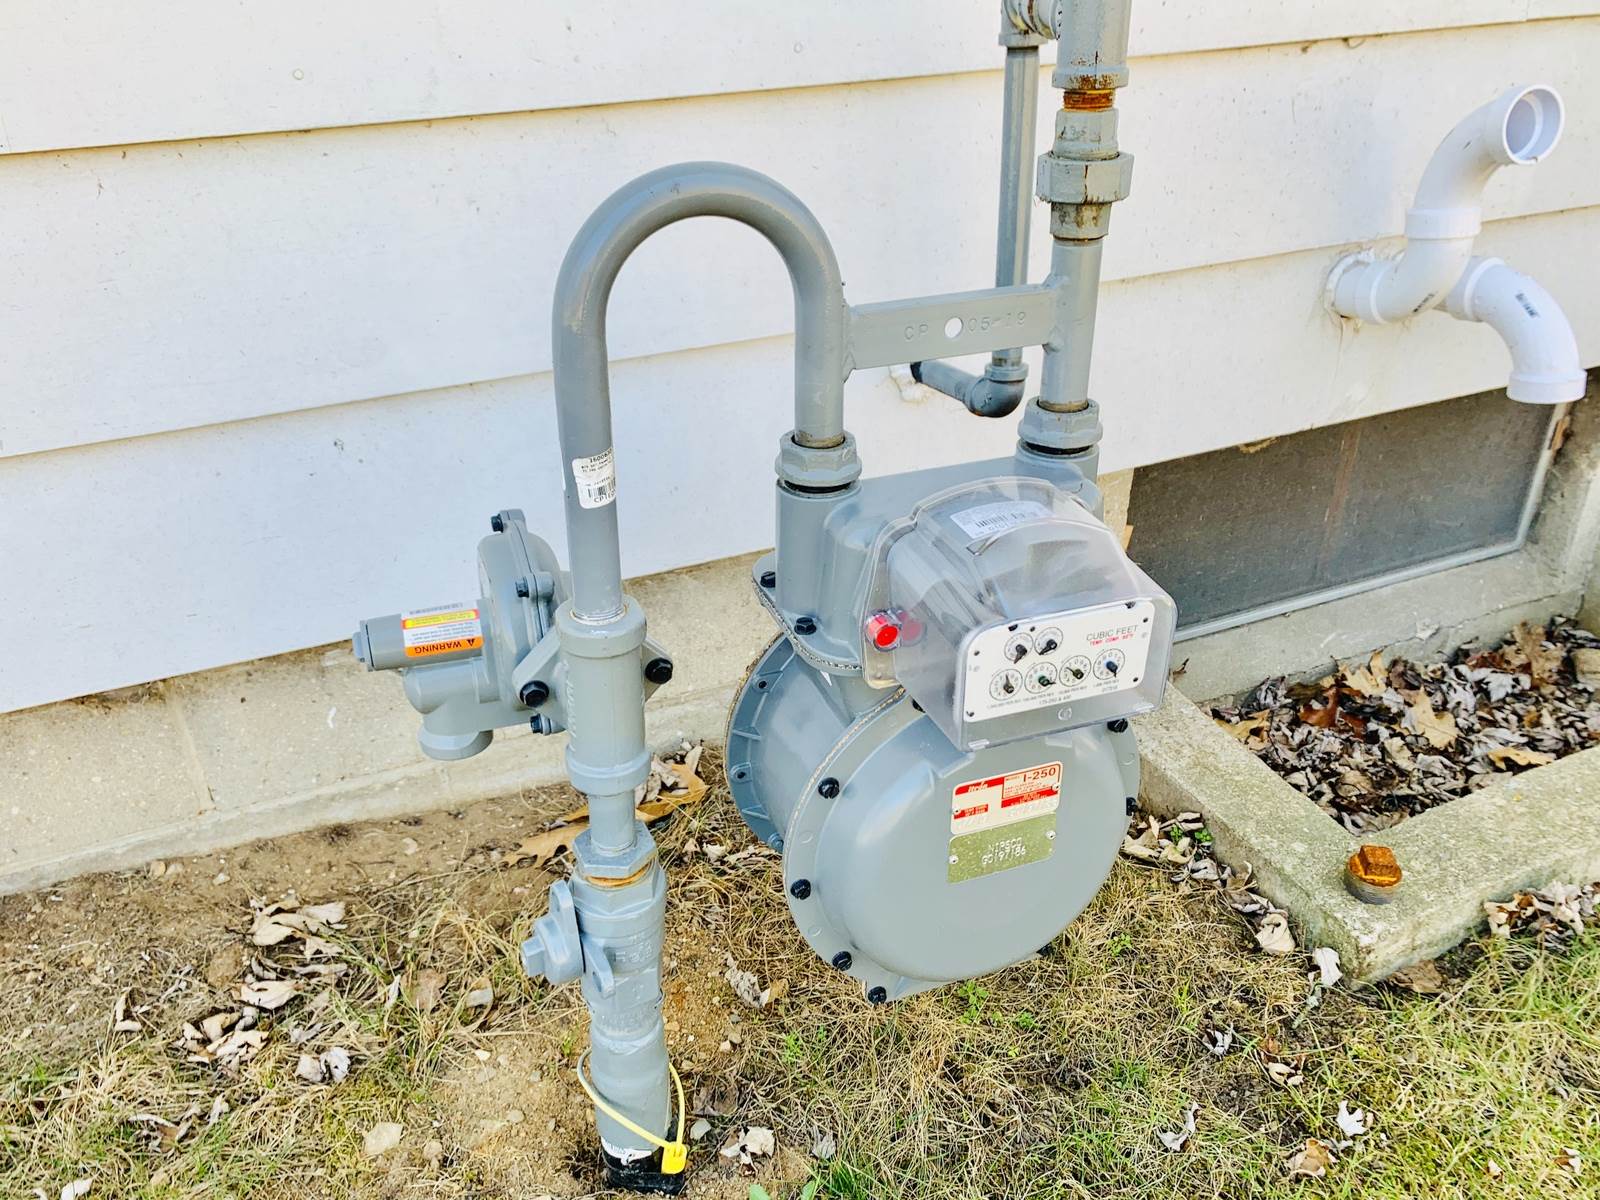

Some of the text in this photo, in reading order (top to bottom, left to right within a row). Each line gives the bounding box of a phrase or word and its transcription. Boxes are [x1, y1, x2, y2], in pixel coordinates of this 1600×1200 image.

[904, 323, 929, 341] CP
[1086, 625, 1139, 641] CUBIC FEET
[414, 641, 462, 654] WARNING
[1023, 767, 1056, 783] I-250
